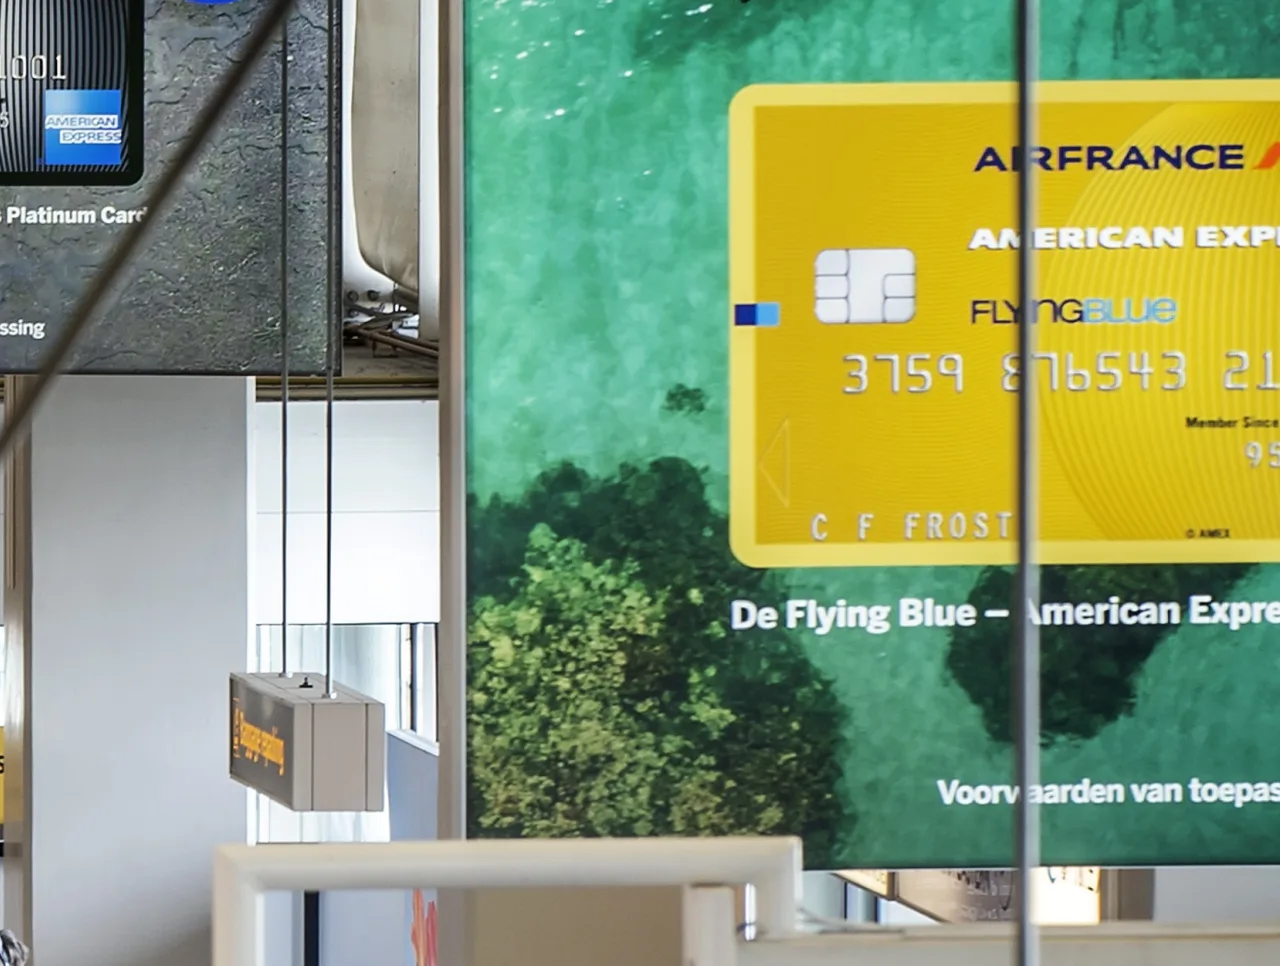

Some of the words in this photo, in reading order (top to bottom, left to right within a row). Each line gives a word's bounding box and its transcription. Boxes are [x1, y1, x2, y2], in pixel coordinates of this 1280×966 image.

[45, 116, 117, 129] AMERICAN
[60, 130, 122, 144] EXPRESS
[7, 206, 96, 225] Platinum
[967, 226, 1184, 250] AMERICAN
[1196, 225, 1280, 248] EXP
[842, 353, 965, 394] 3759
[1001, 350, 1187, 392] 876543
[1185, 416, 1239, 429] Member
[1243, 415, 1280, 429] Since
[811, 513, 829, 541] C
[857, 512, 874, 541] F
[904, 511, 1014, 541] FROST
[730, 599, 780, 631] De
[786, 598, 892, 635] Flying
[898, 597, 978, 629] Blue
[1130, 781, 1184, 804] van
